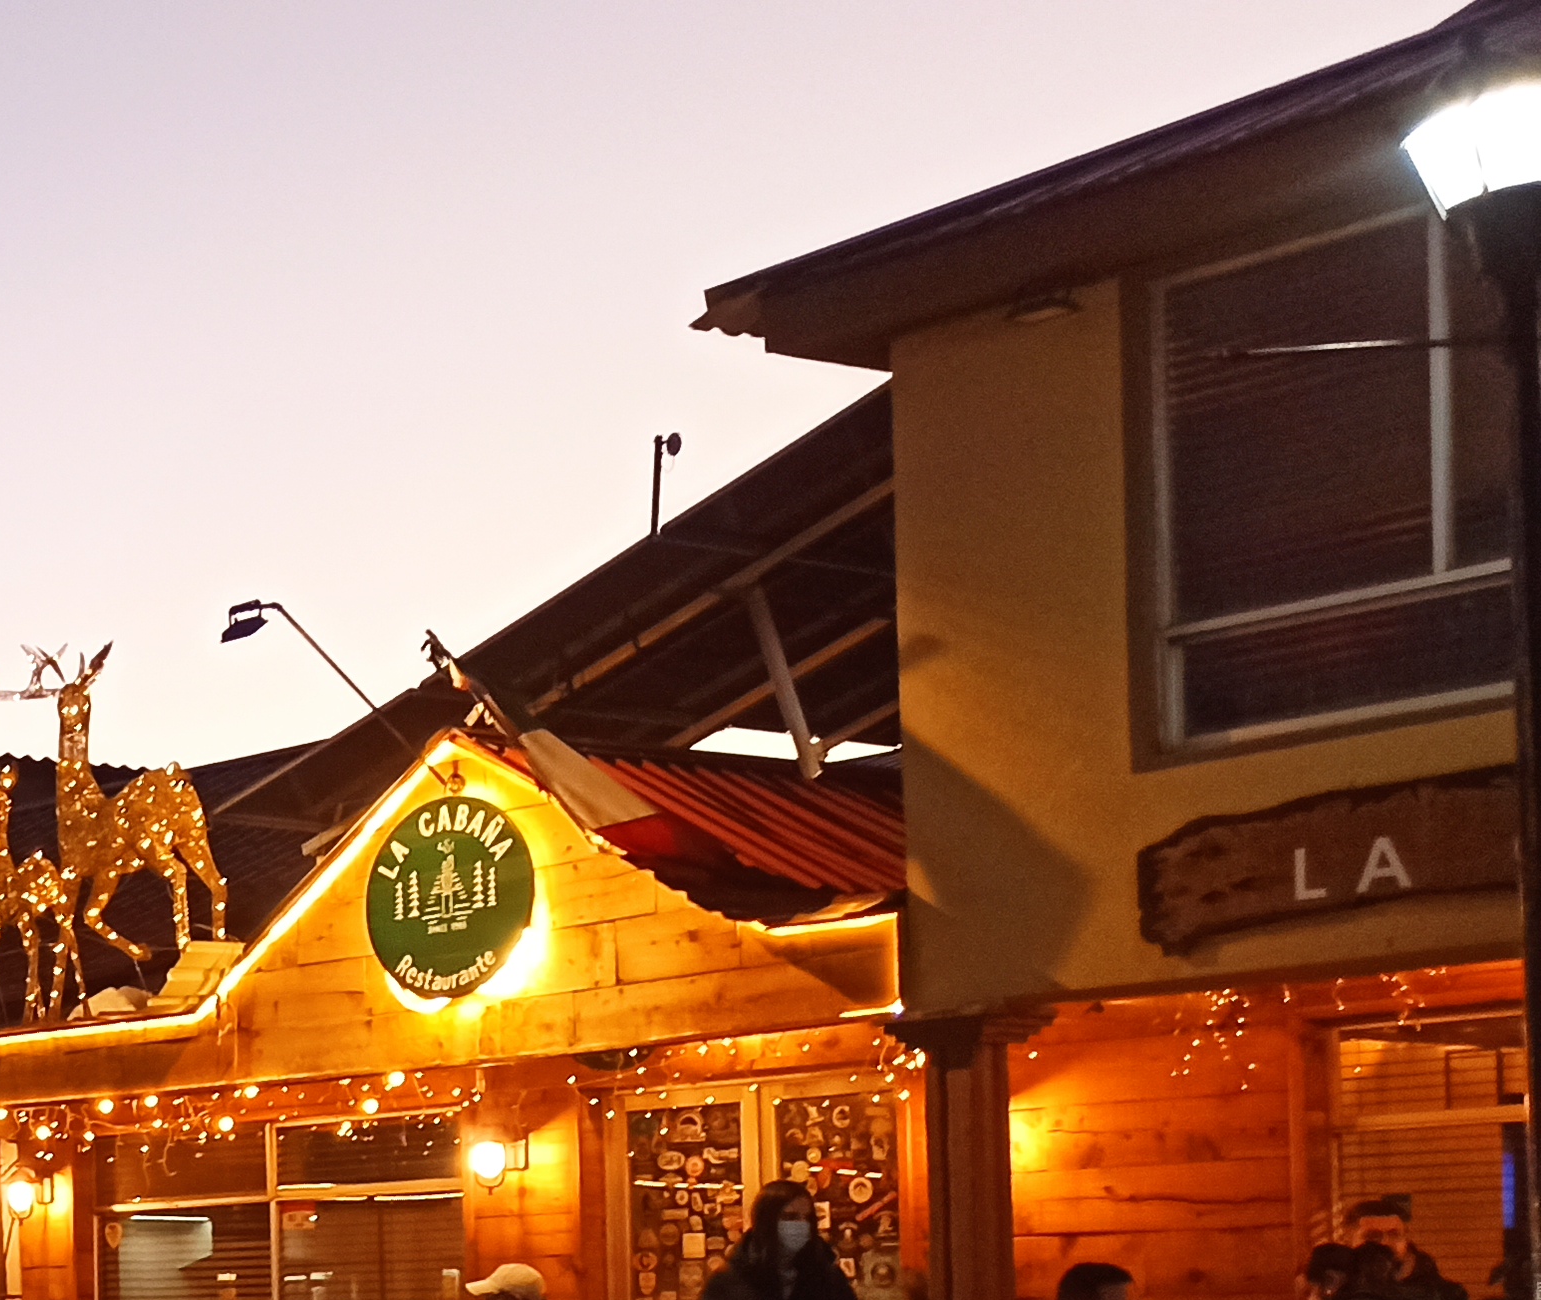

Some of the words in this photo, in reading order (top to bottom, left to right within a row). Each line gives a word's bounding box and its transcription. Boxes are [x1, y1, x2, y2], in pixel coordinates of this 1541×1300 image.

[377, 840, 410, 880] LA
[418, 803, 514, 861] CABAÑA
[1294, 836, 1412, 900] LA
[395, 950, 497, 991] Restaurante
